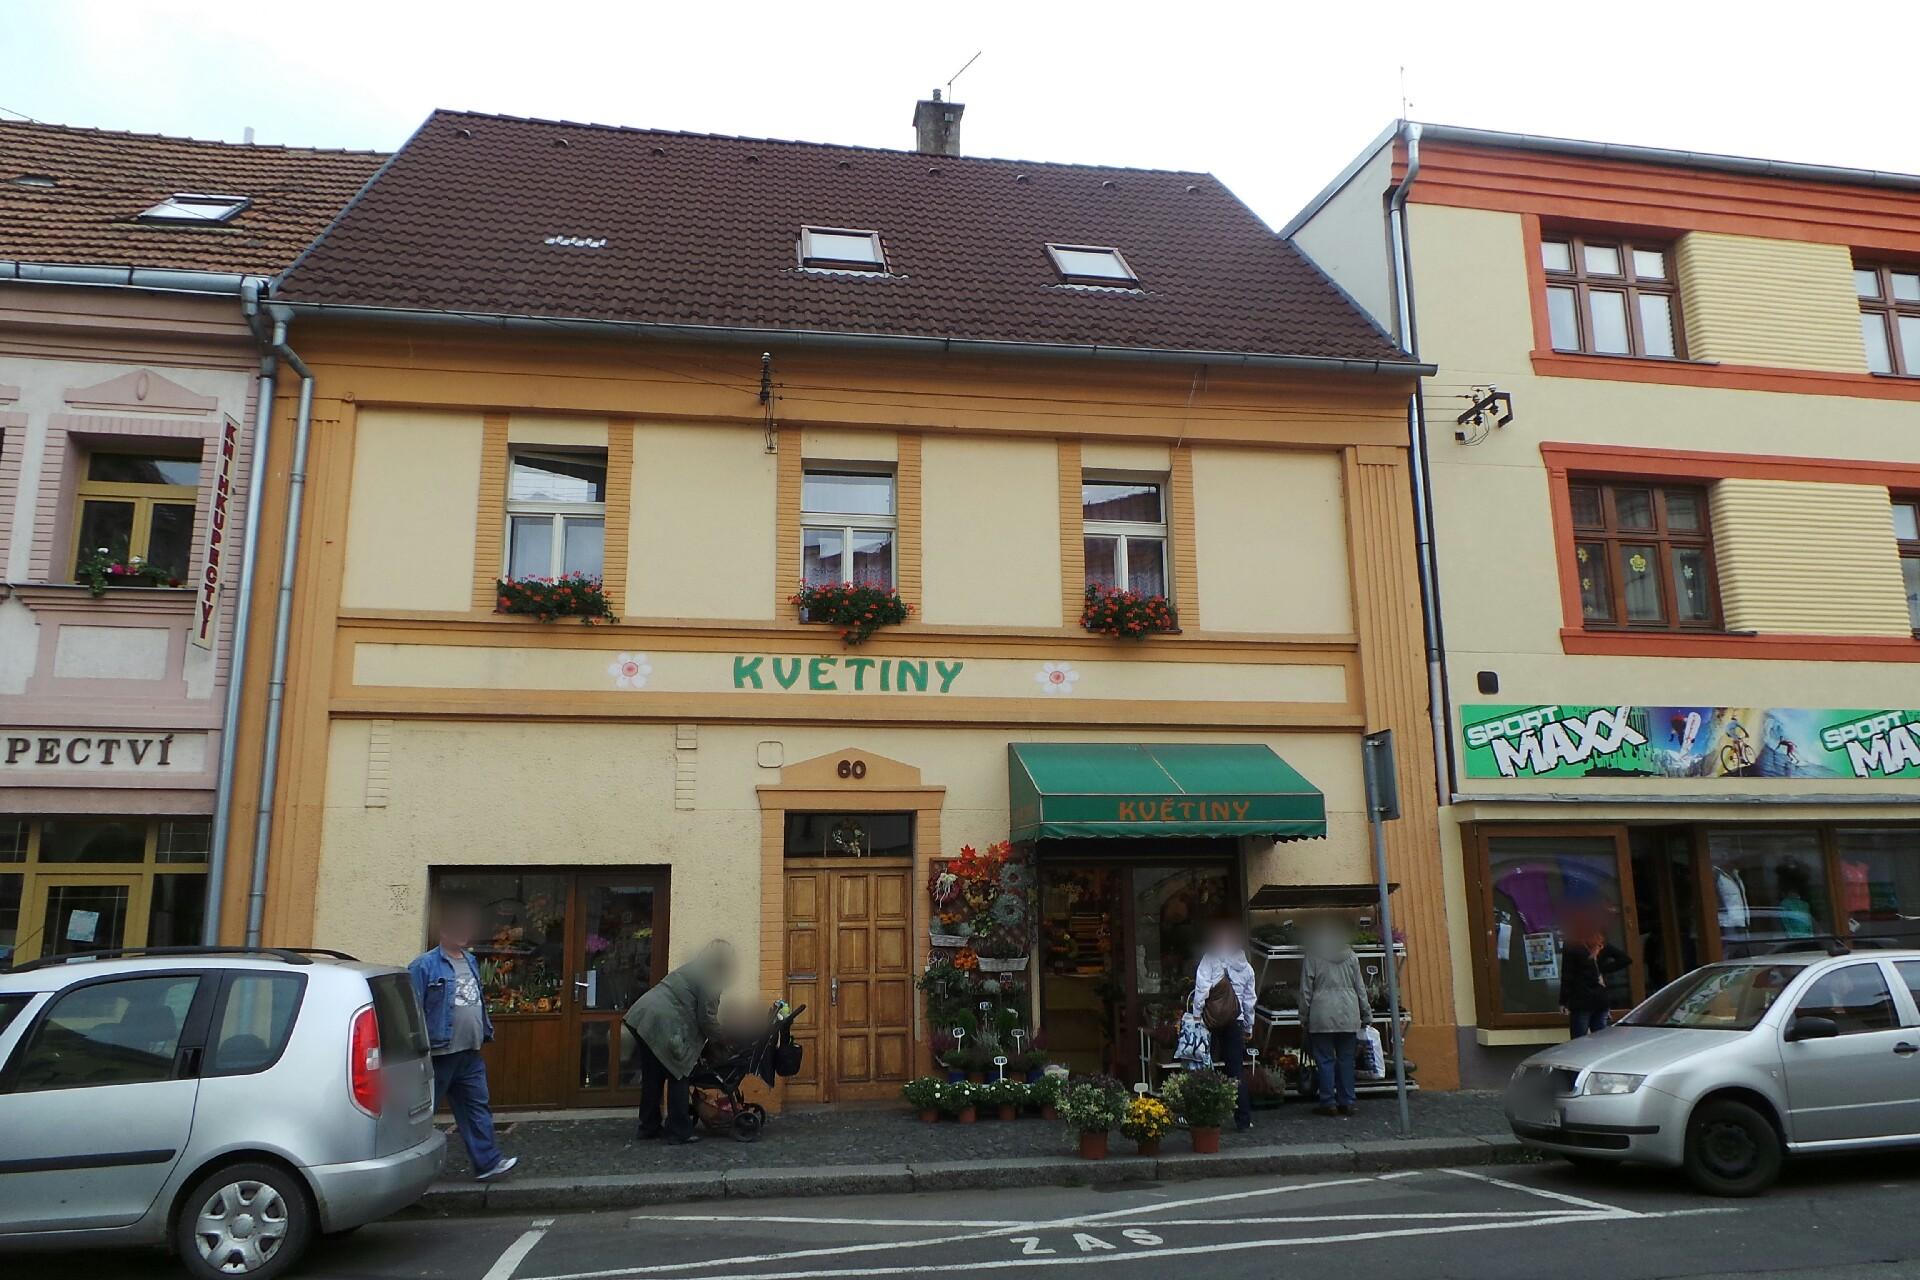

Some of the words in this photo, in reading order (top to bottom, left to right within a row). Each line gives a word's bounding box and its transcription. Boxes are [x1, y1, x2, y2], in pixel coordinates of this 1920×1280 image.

[733, 655, 964, 693] KVĚTINY
[1467, 705, 1559, 747] SPORT
[1490, 704, 1649, 778] MAXX
[1823, 711, 1904, 749] SPORT
[4, 733, 175, 766] PECTVÍ
[837, 759, 867, 779] 60
[1119, 797, 1250, 822] KVĚTINY
